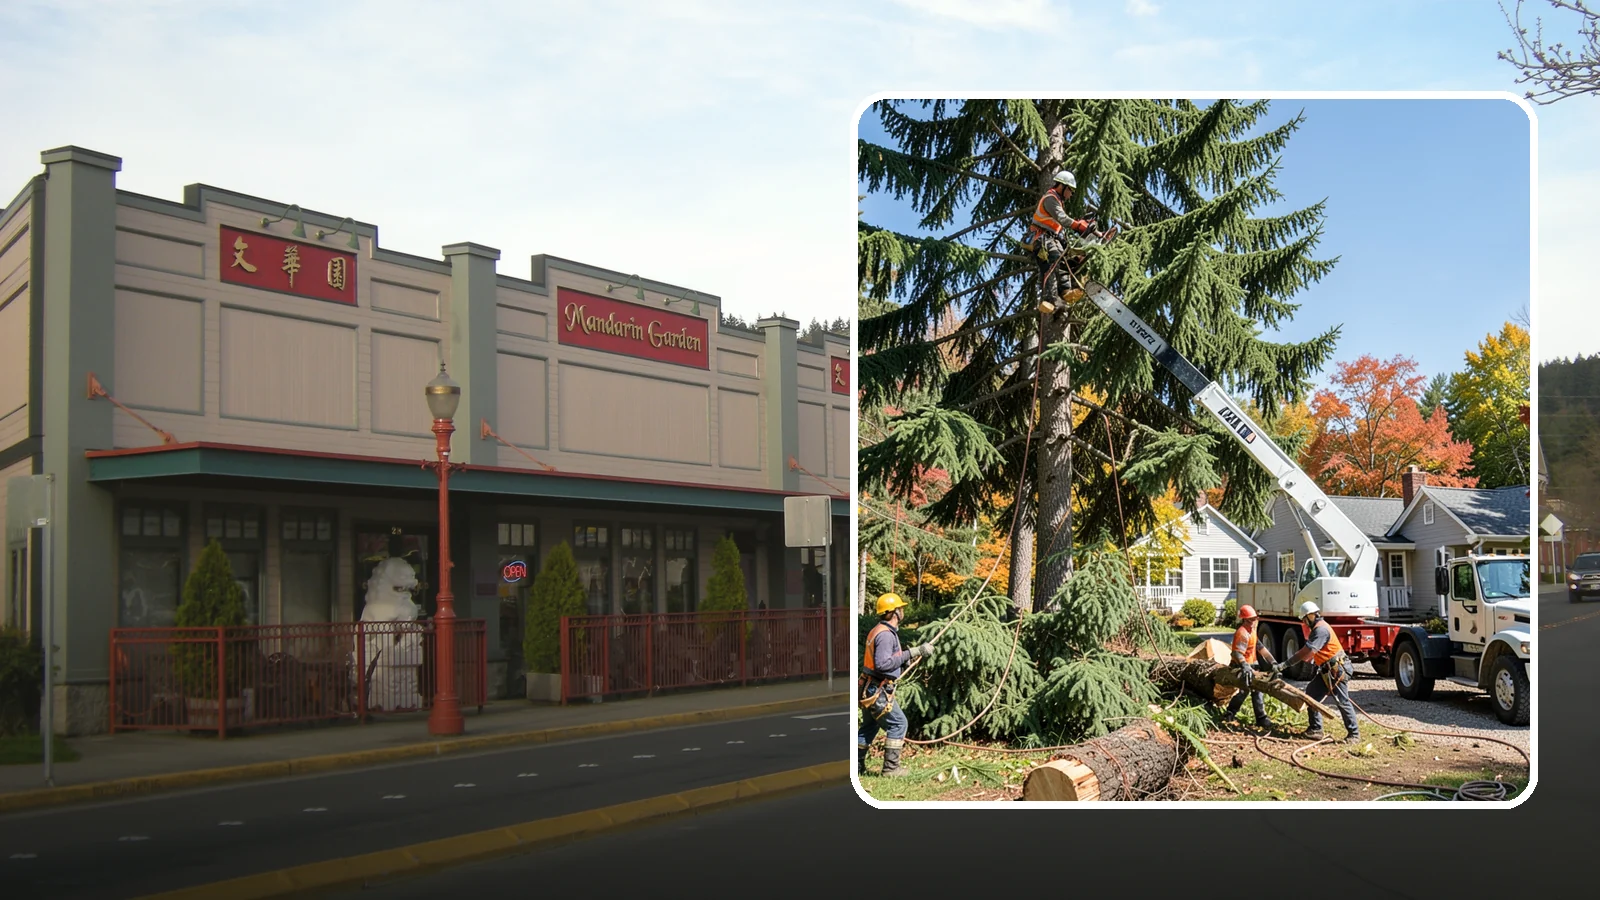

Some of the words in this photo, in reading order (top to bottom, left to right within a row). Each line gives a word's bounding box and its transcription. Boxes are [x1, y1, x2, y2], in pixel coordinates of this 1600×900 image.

[230, 235, 346, 291] 文華園
[564, 302, 644, 341] Mandarin
[647, 320, 702, 352] Garden
[503, 565, 527, 578] OPEN
